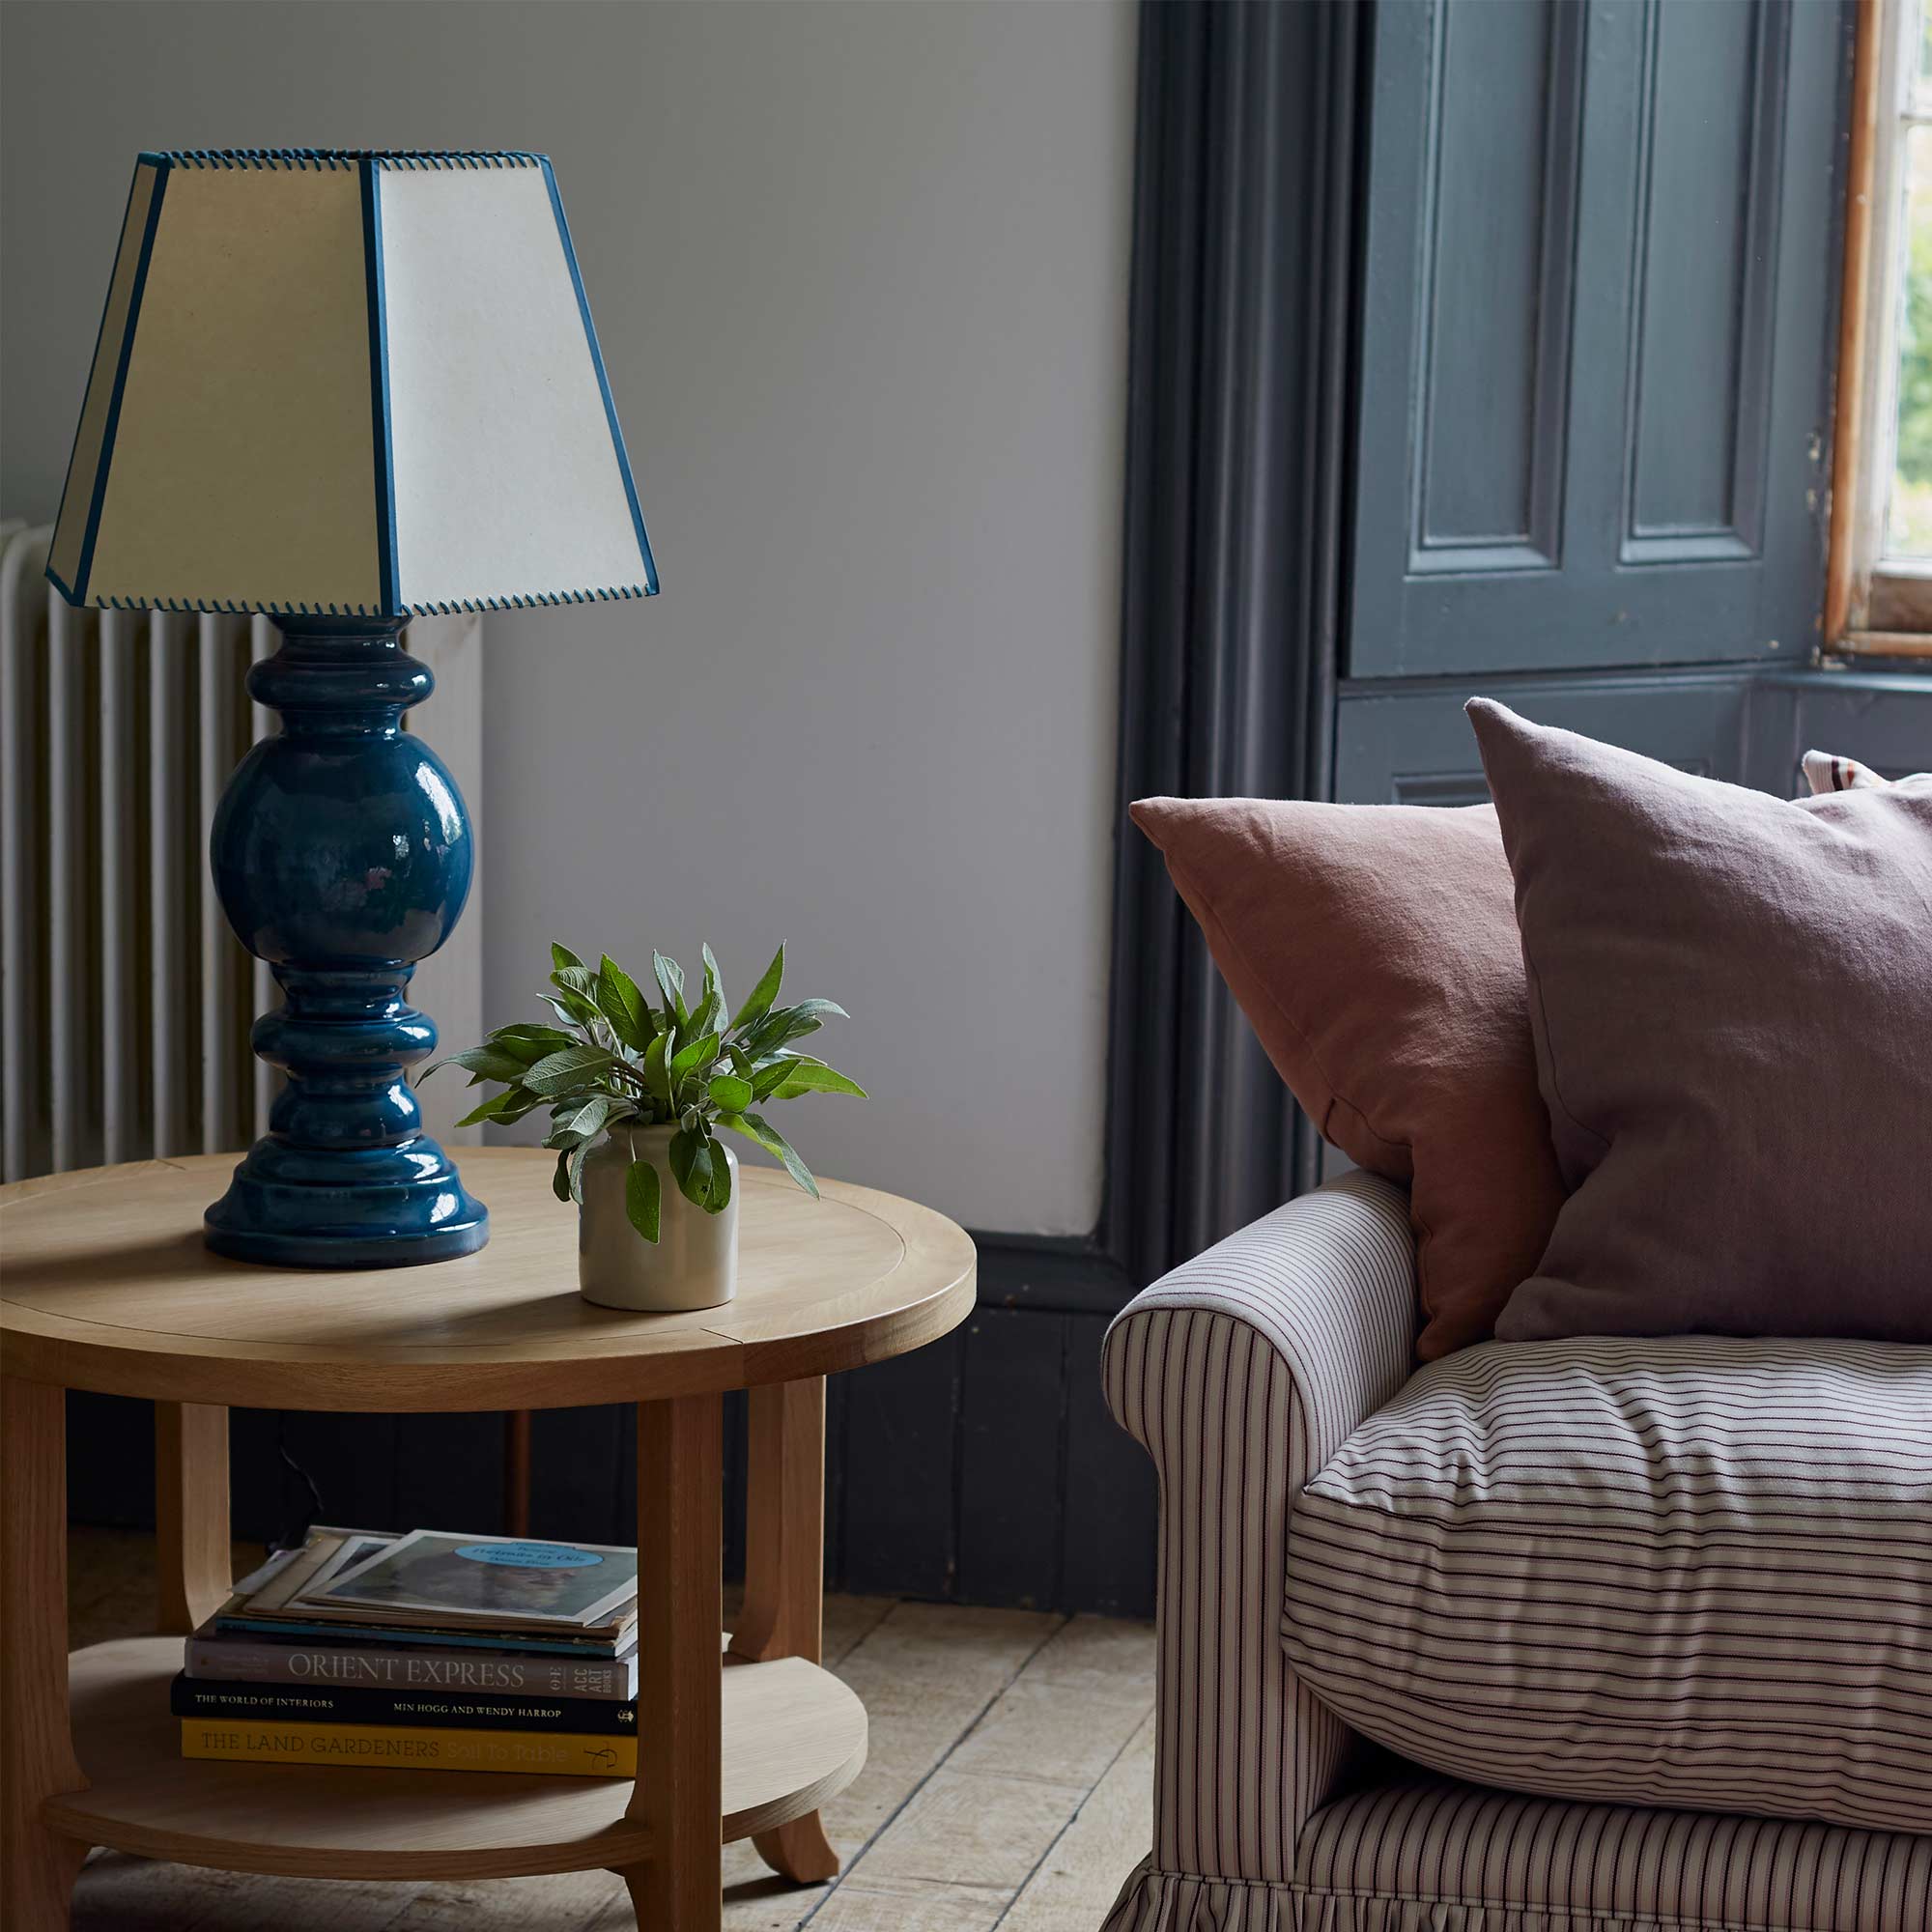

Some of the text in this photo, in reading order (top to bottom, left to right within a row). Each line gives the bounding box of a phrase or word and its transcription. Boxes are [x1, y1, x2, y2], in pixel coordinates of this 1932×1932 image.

[288, 1653, 399, 1681] ORIENT
[407, 1660, 525, 1688] EXPRESS
[574, 1668, 588, 1692] ACC
[588, 1668, 603, 1692] ART
[603, 1669, 611, 1693] BOOKS
[195, 1694, 334, 1709] THE WORLD OF INTERIORS
[393, 1703, 562, 1719] MIN HOGG AND WENDY HARROP
[202, 1732, 568, 1763] THE LAND GARDENERS Soil To Table
